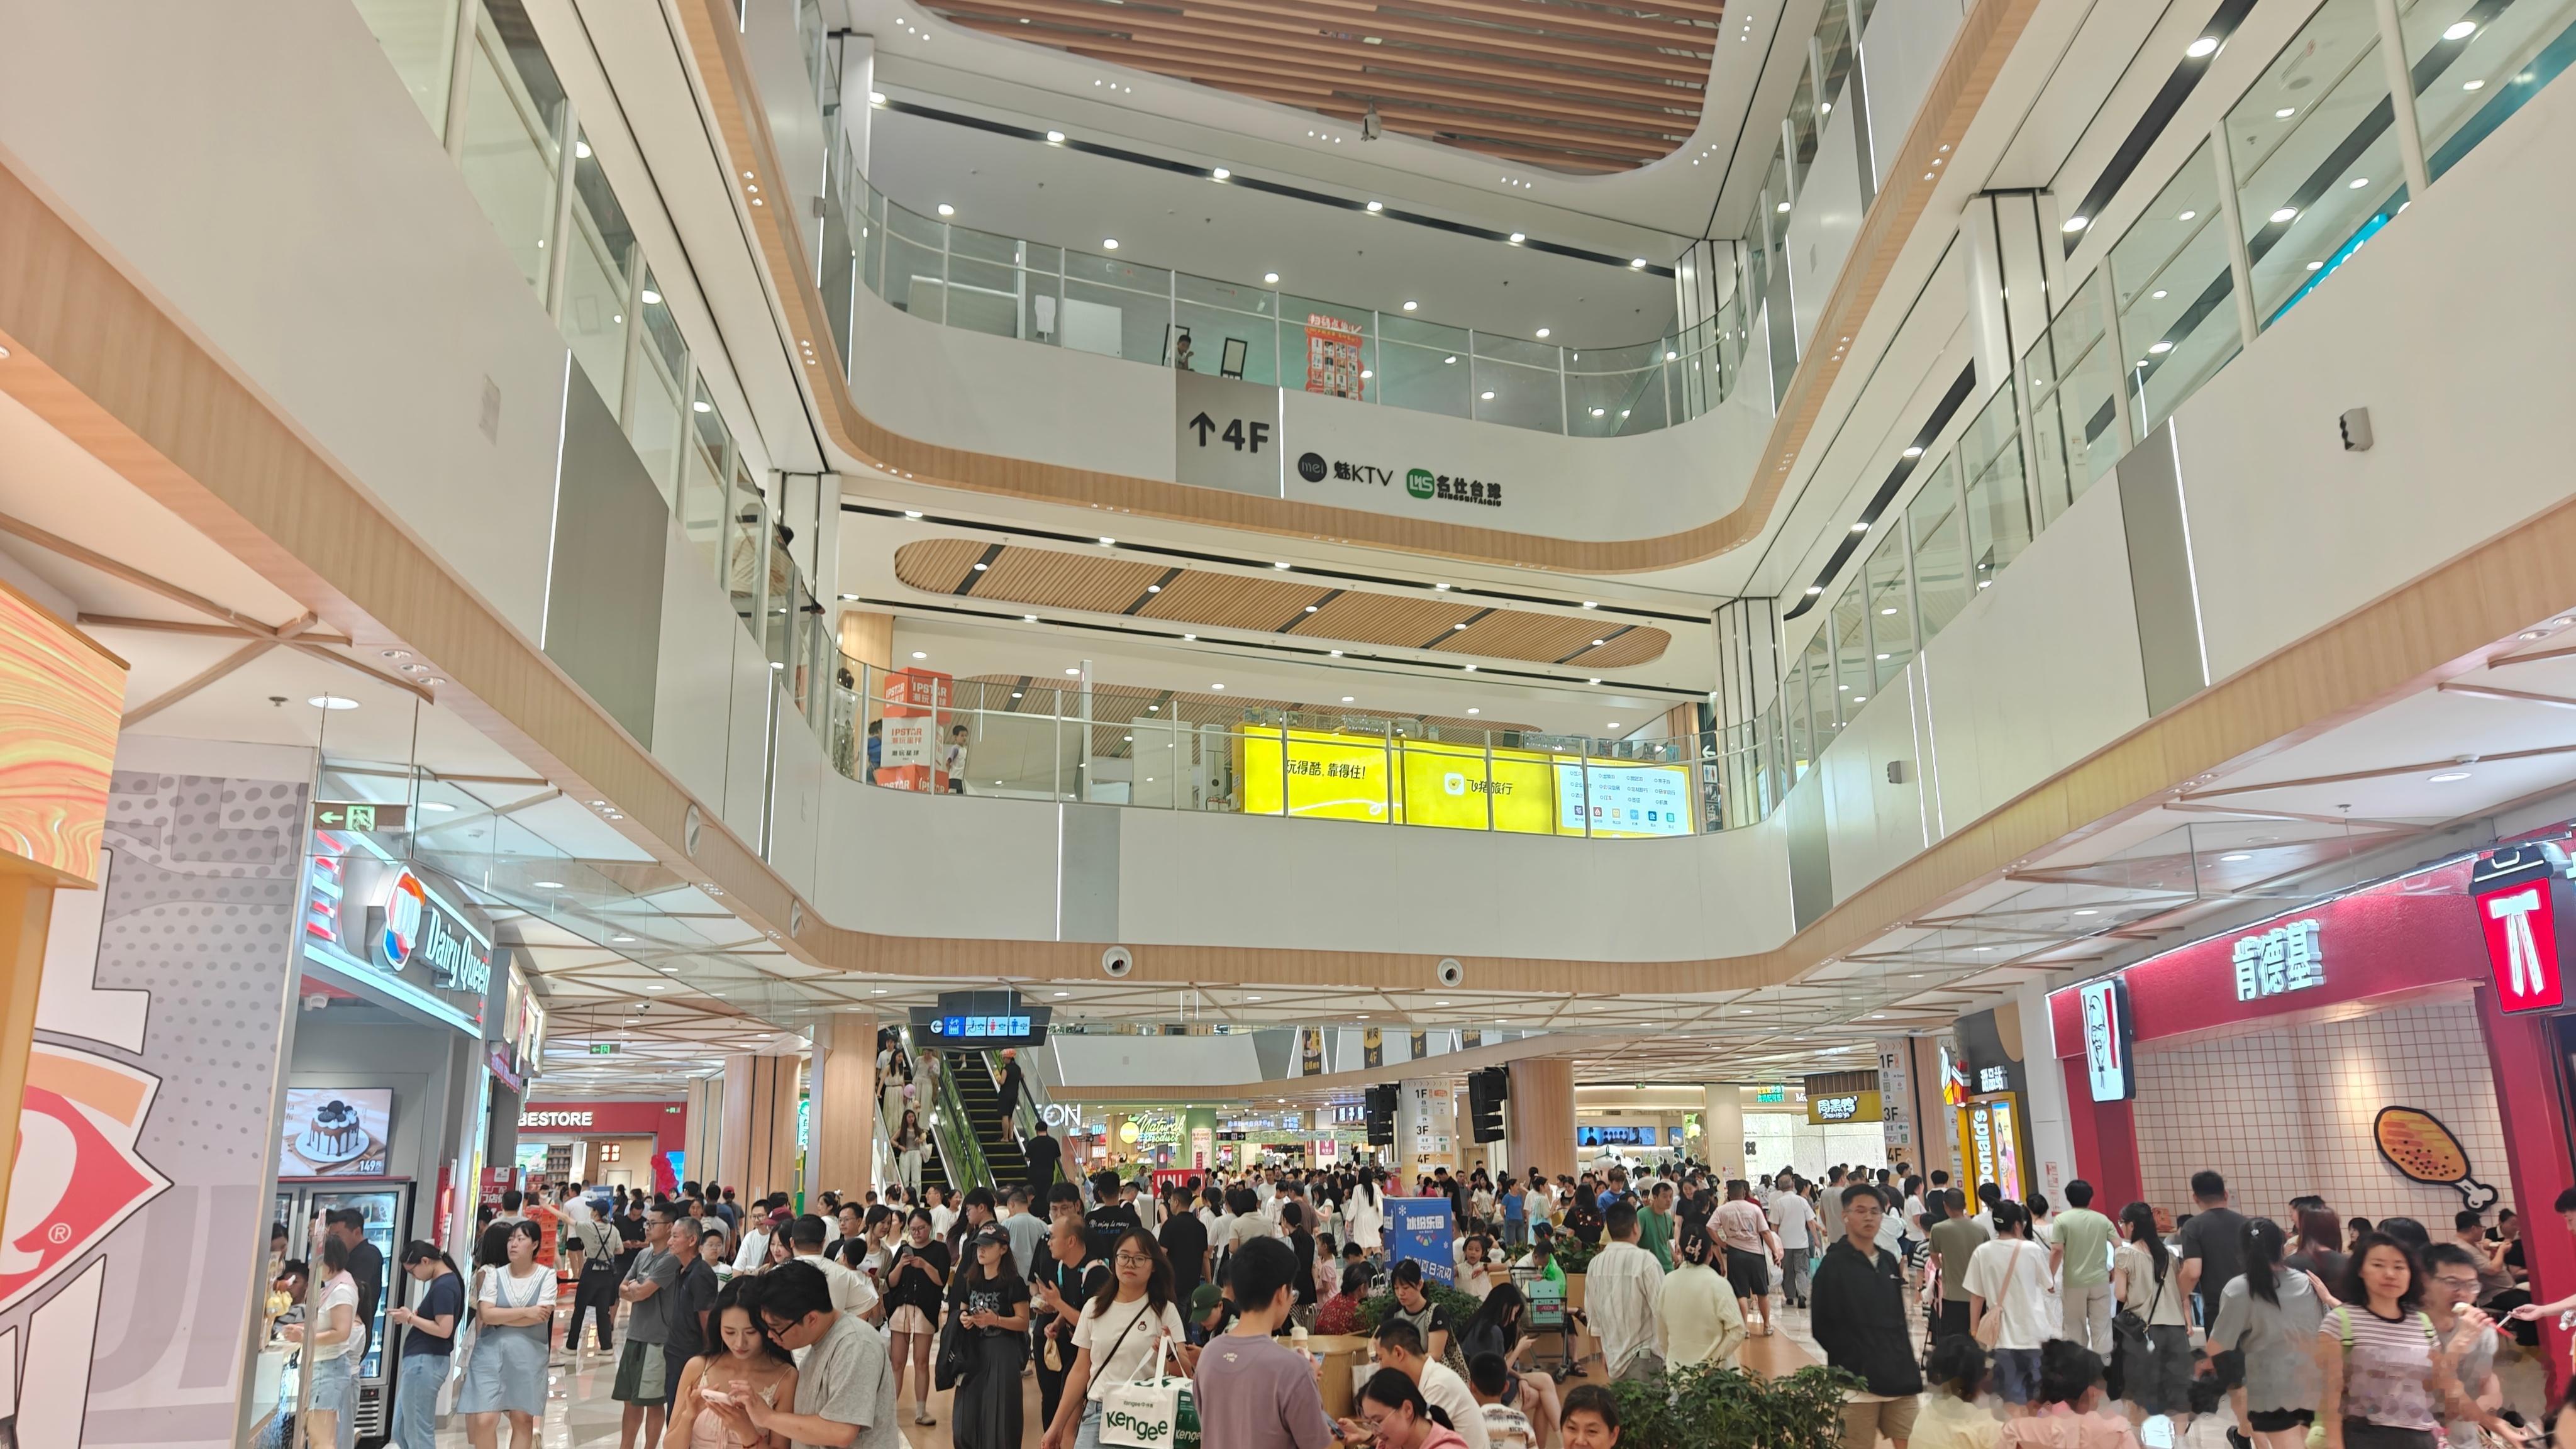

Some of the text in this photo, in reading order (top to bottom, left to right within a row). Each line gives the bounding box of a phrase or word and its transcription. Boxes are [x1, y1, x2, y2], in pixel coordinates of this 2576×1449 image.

[1222, 419, 1270, 453] 4F
[1333, 460, 1393, 486] 魅KTV
[913, 682, 947, 697] IPSR
[913, 693, 947, 706] 潮玩球
[891, 728, 923, 736] IPSTAR
[425, 906, 492, 996] Dairy Queen
[2232, 919, 2326, 1002] 肯德基
[1879, 1054, 1894, 1069] 1F
[1415, 1089, 1428, 1099] 1F
[1817, 1097, 1856, 1114] 周黑鸭
[518, 1111, 593, 1127] BESTORE
[1884, 1106, 1898, 1121] 3F
[1416, 1125, 1429, 1135] 3F
[1417, 1153, 1430, 1163] 4F
[1887, 1147, 1902, 1162] 4F
[359, 1160, 376, 1172] 149
[1406, 1215, 1444, 1230] 冰纷乐园
